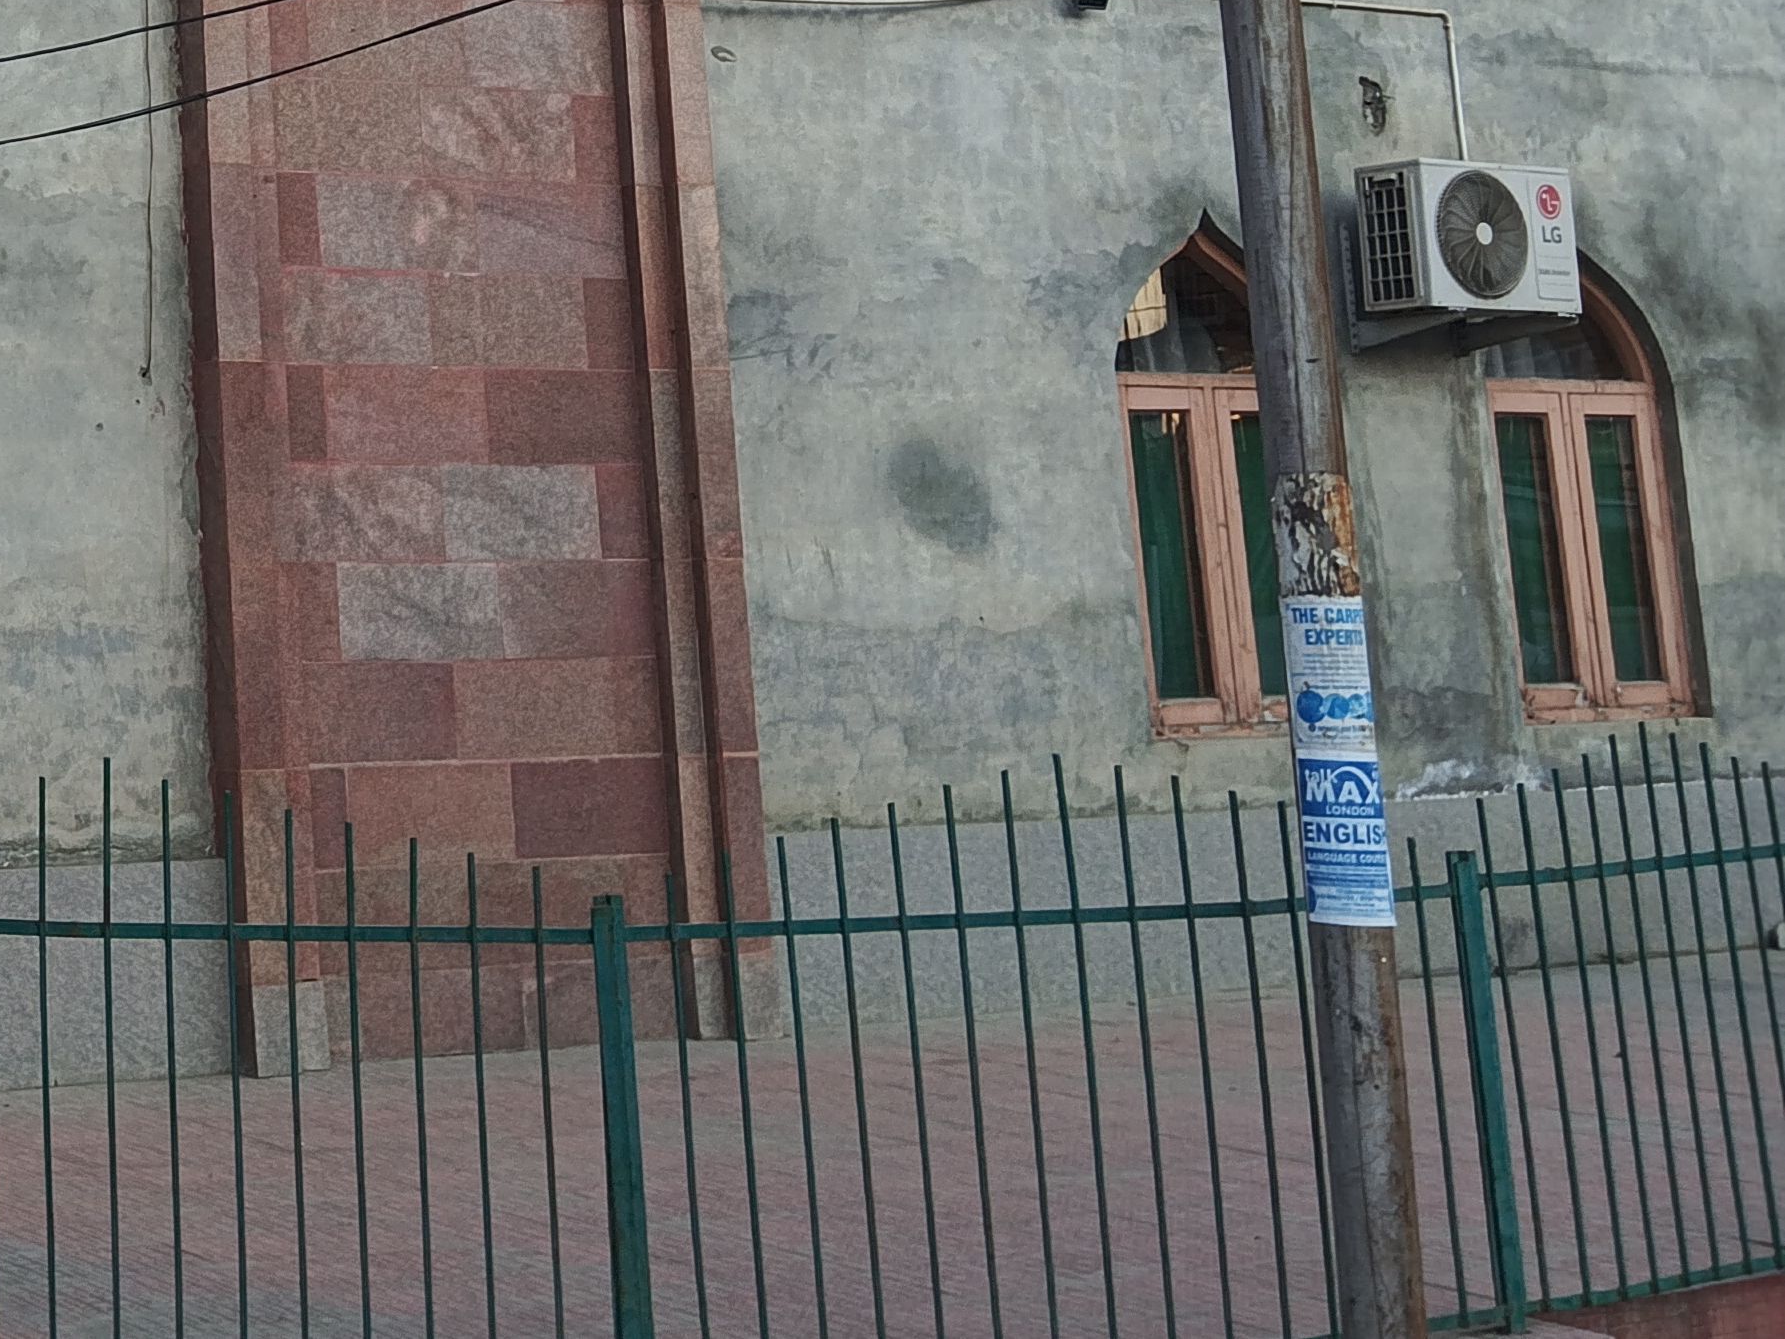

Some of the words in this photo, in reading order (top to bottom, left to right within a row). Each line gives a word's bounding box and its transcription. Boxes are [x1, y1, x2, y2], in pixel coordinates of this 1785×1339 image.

[1541, 225, 1562, 244] LG
[1291, 607, 1319, 624] THE
[1306, 781, 1380, 804] MAX
[1326, 805, 1375, 816] LONDON
[1303, 821, 1386, 845] ENGLIS
